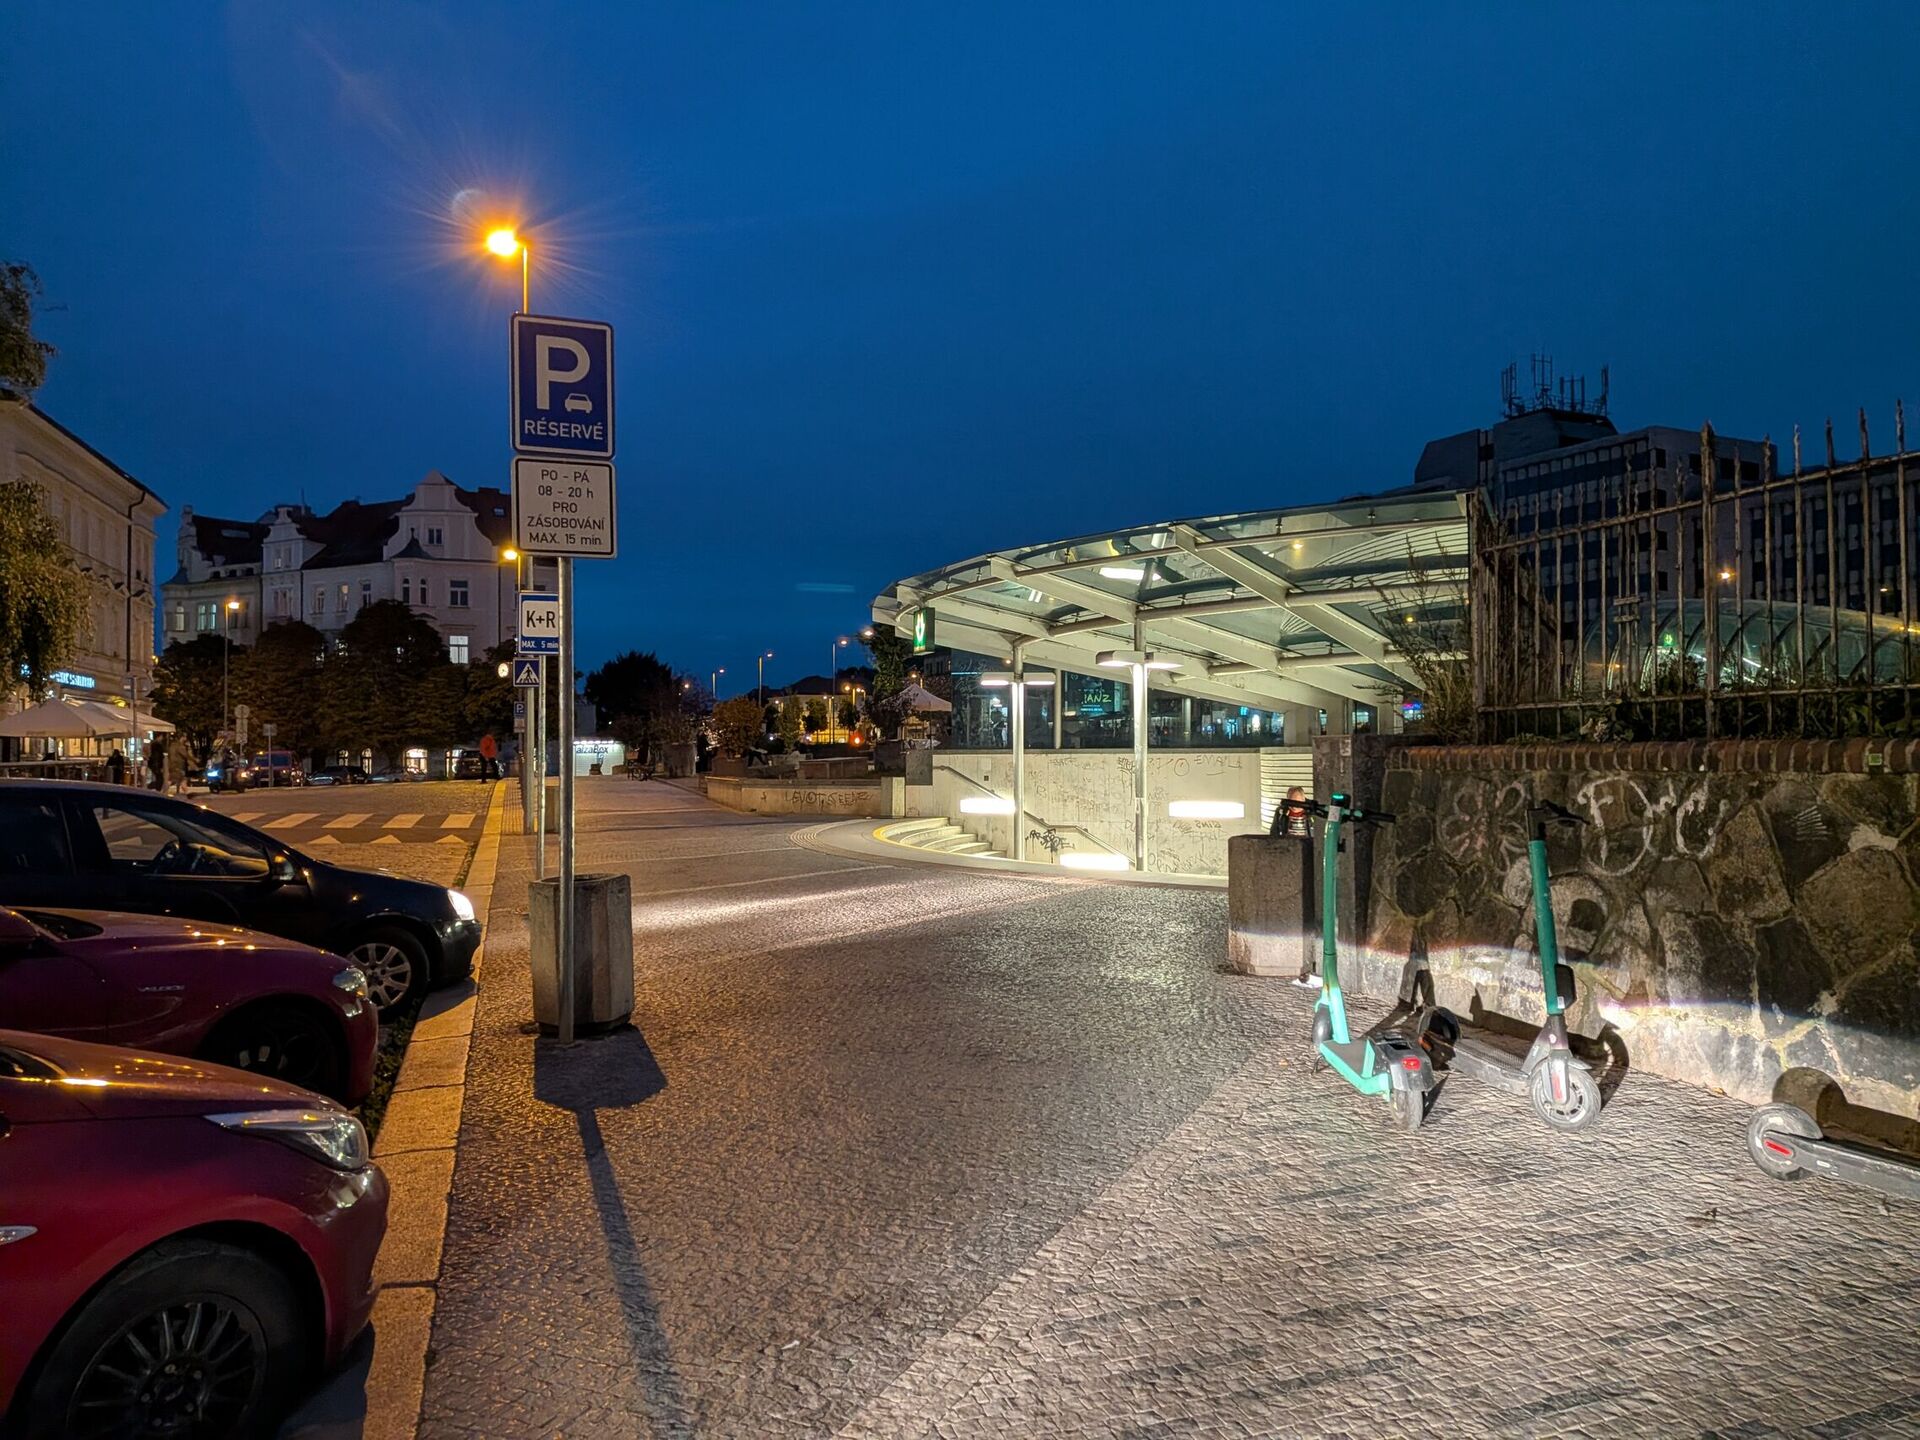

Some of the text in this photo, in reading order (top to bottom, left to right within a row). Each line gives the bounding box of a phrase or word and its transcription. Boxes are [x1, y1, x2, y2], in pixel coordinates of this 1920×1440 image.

[536, 335, 591, 411] P
[524, 417, 604, 440] RÉSERVÉ
[541, 469, 558, 481] PO
[573, 470, 590, 483] PÁ
[538, 485, 552, 496] 08
[568, 486, 582, 498] 20
[586, 488, 594, 499] h
[552, 502, 578, 513] PRO
[527, 514, 605, 530] ZÁSOBOVÁNÍ
[529, 532, 560, 544] MAX.
[565, 534, 576, 545] 15
[526, 610, 556, 629] K+R
[541, 640, 546, 649] 5
[516, 703, 524, 713] P
